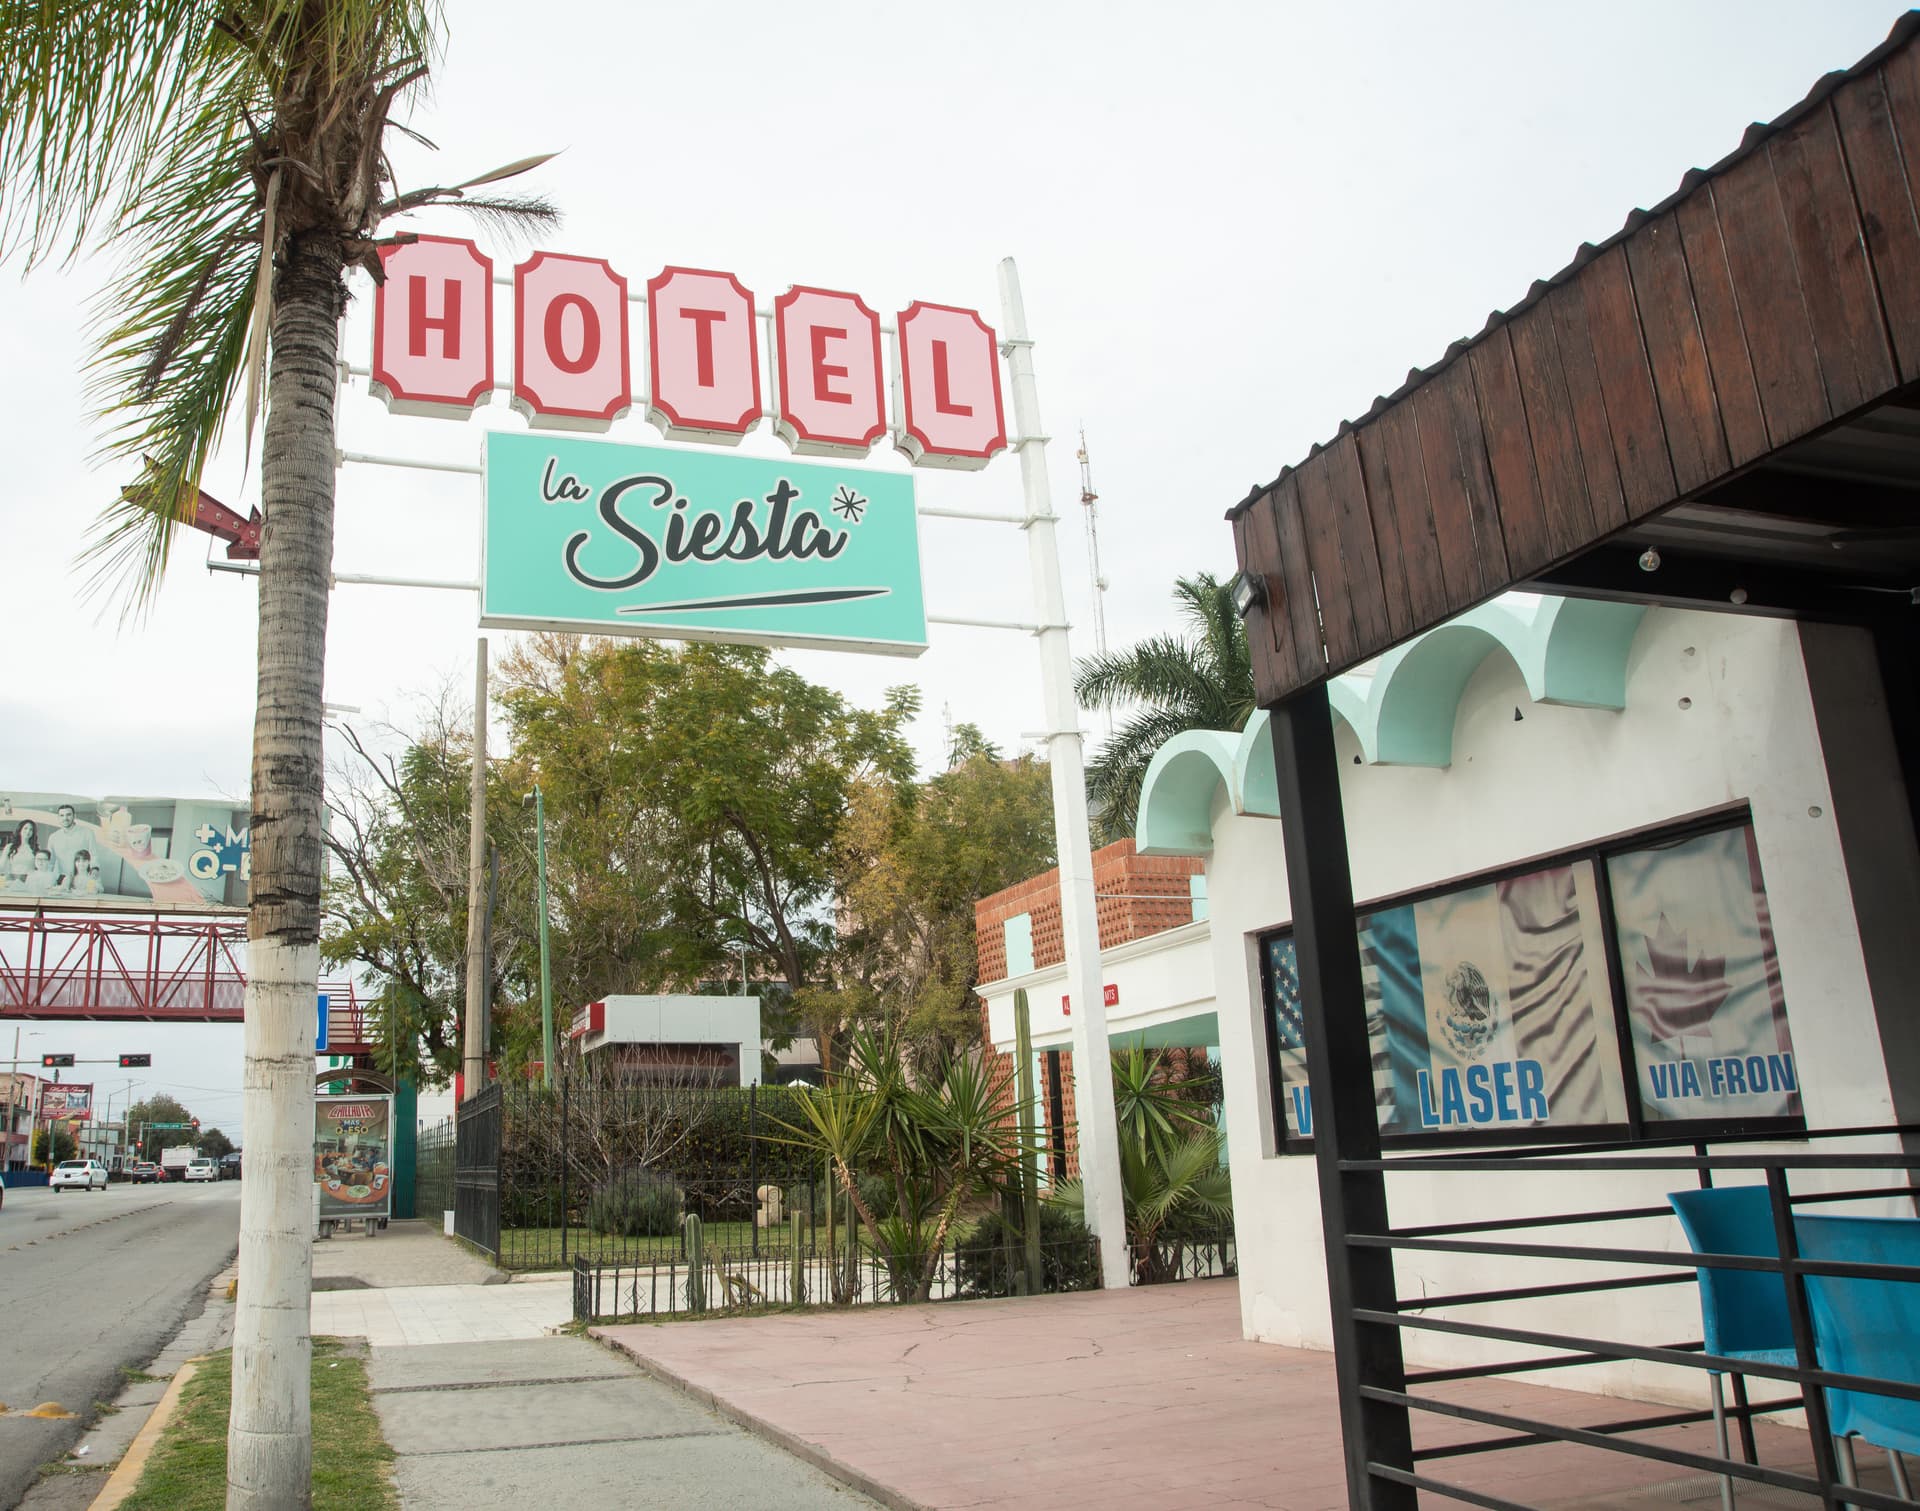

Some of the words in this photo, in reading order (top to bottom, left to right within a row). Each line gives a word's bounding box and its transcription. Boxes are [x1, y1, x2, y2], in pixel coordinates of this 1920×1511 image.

[408, 275, 973, 417] HOTEL
[543, 457, 590, 502] la
[565, 474, 849, 590] Siesta
[1418, 1059, 1549, 1127] LASER
[1649, 1061, 1702, 1099] VIA
[1708, 1052, 1797, 1095] FRON
